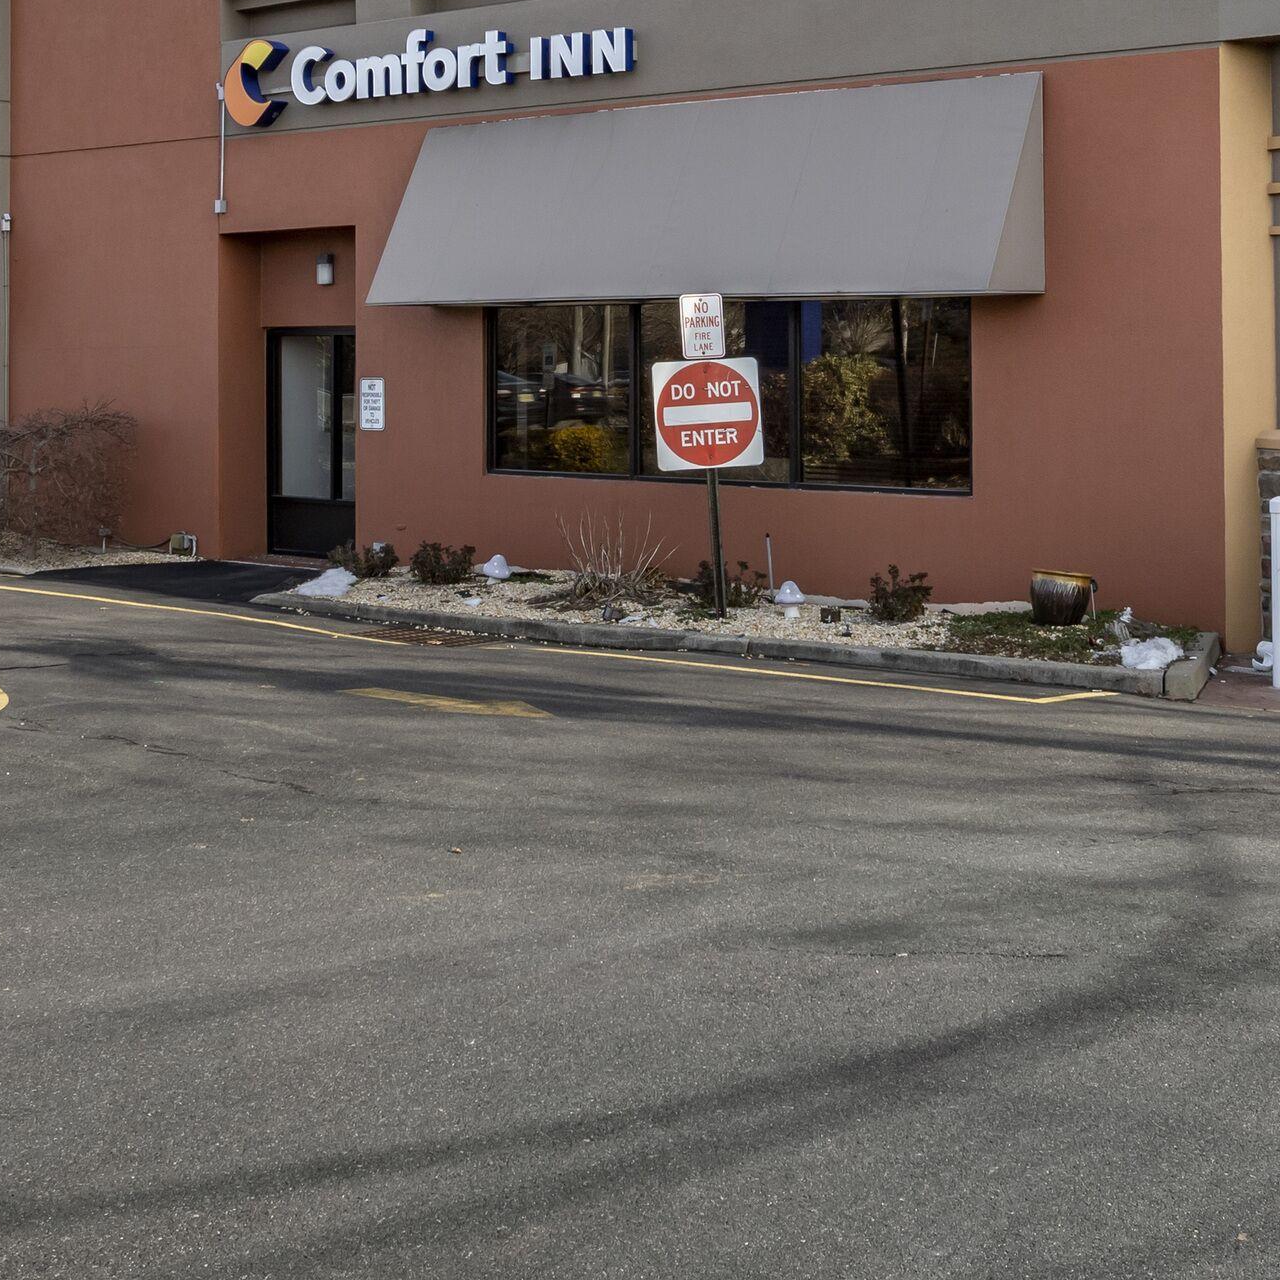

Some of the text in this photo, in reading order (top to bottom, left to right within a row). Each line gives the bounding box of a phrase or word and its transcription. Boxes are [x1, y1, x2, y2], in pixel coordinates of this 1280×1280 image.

[291, 29, 510, 106] Comfort
[530, 27, 631, 81] INN
[694, 302, 708, 314] NO
[685, 316, 720, 328] PARKING
[694, 332, 711, 341] FIRE
[694, 343, 713, 351] LANE
[671, 380, 741, 400] DO NOT
[680, 428, 738, 447] ENTER
